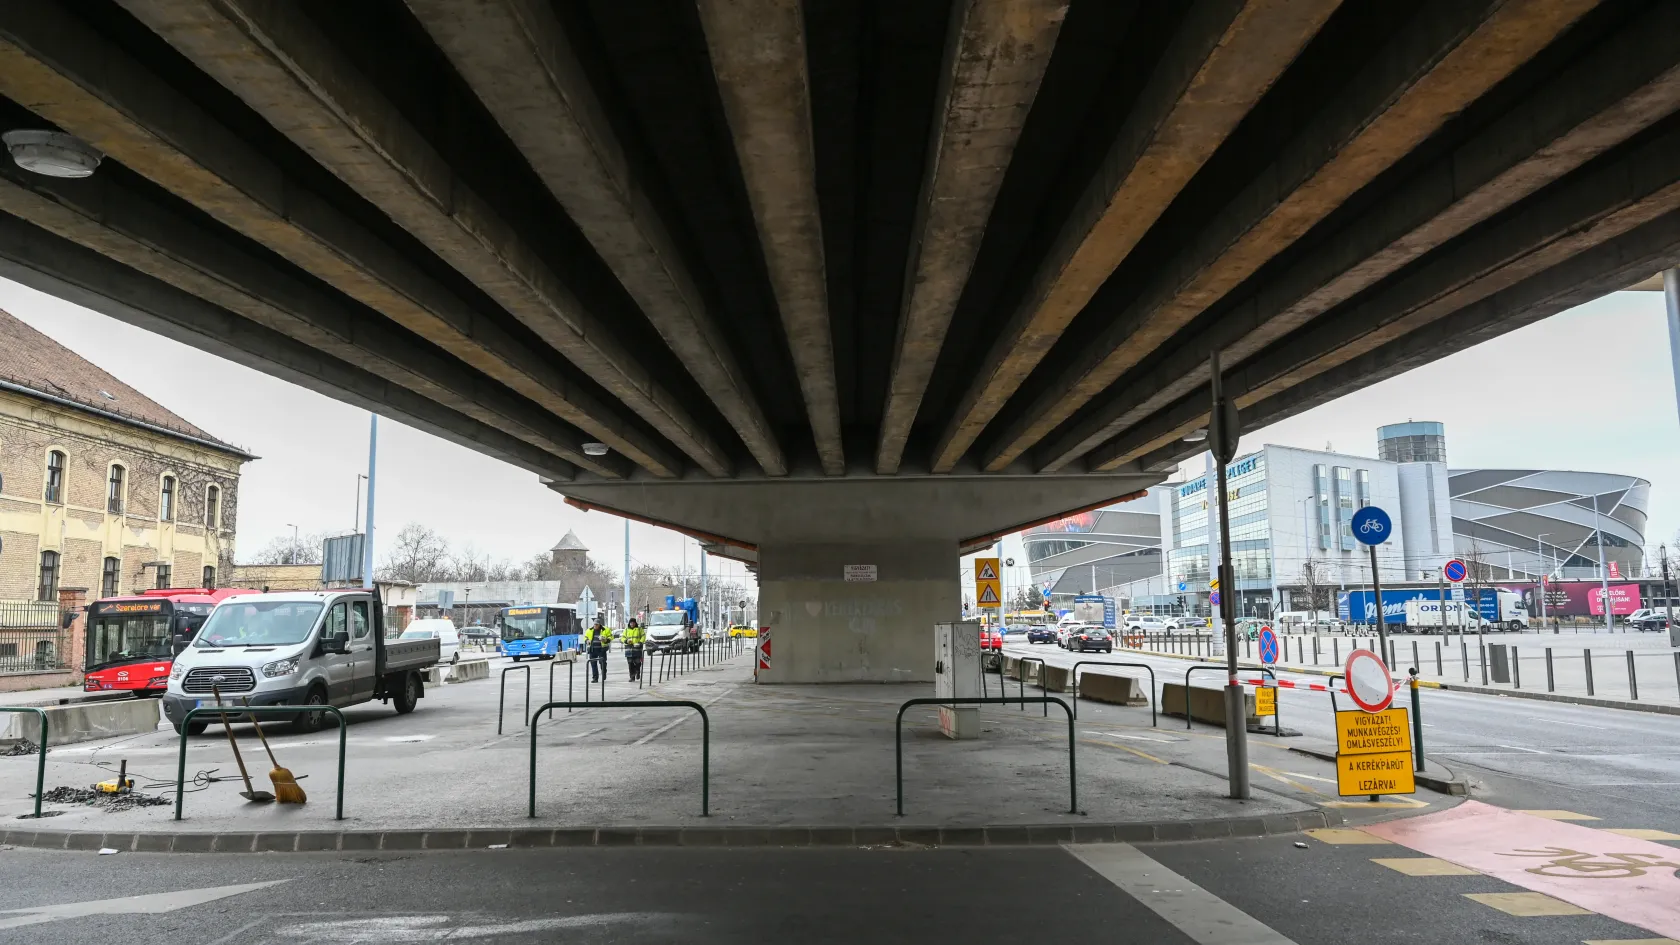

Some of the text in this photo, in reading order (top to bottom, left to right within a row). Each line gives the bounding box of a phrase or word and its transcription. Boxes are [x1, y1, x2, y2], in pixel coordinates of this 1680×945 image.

[1355, 714, 1391, 725] VIGYÁZAT!
[1347, 725, 1401, 738] MUNKAVÉGZÉS!
[1346, 736, 1403, 749] OMLÁSVESZÉLY!
[1349, 759, 1404, 771] A KERÉKPÁRÚT
[1359, 778, 1396, 790] LEZÁRVA!
